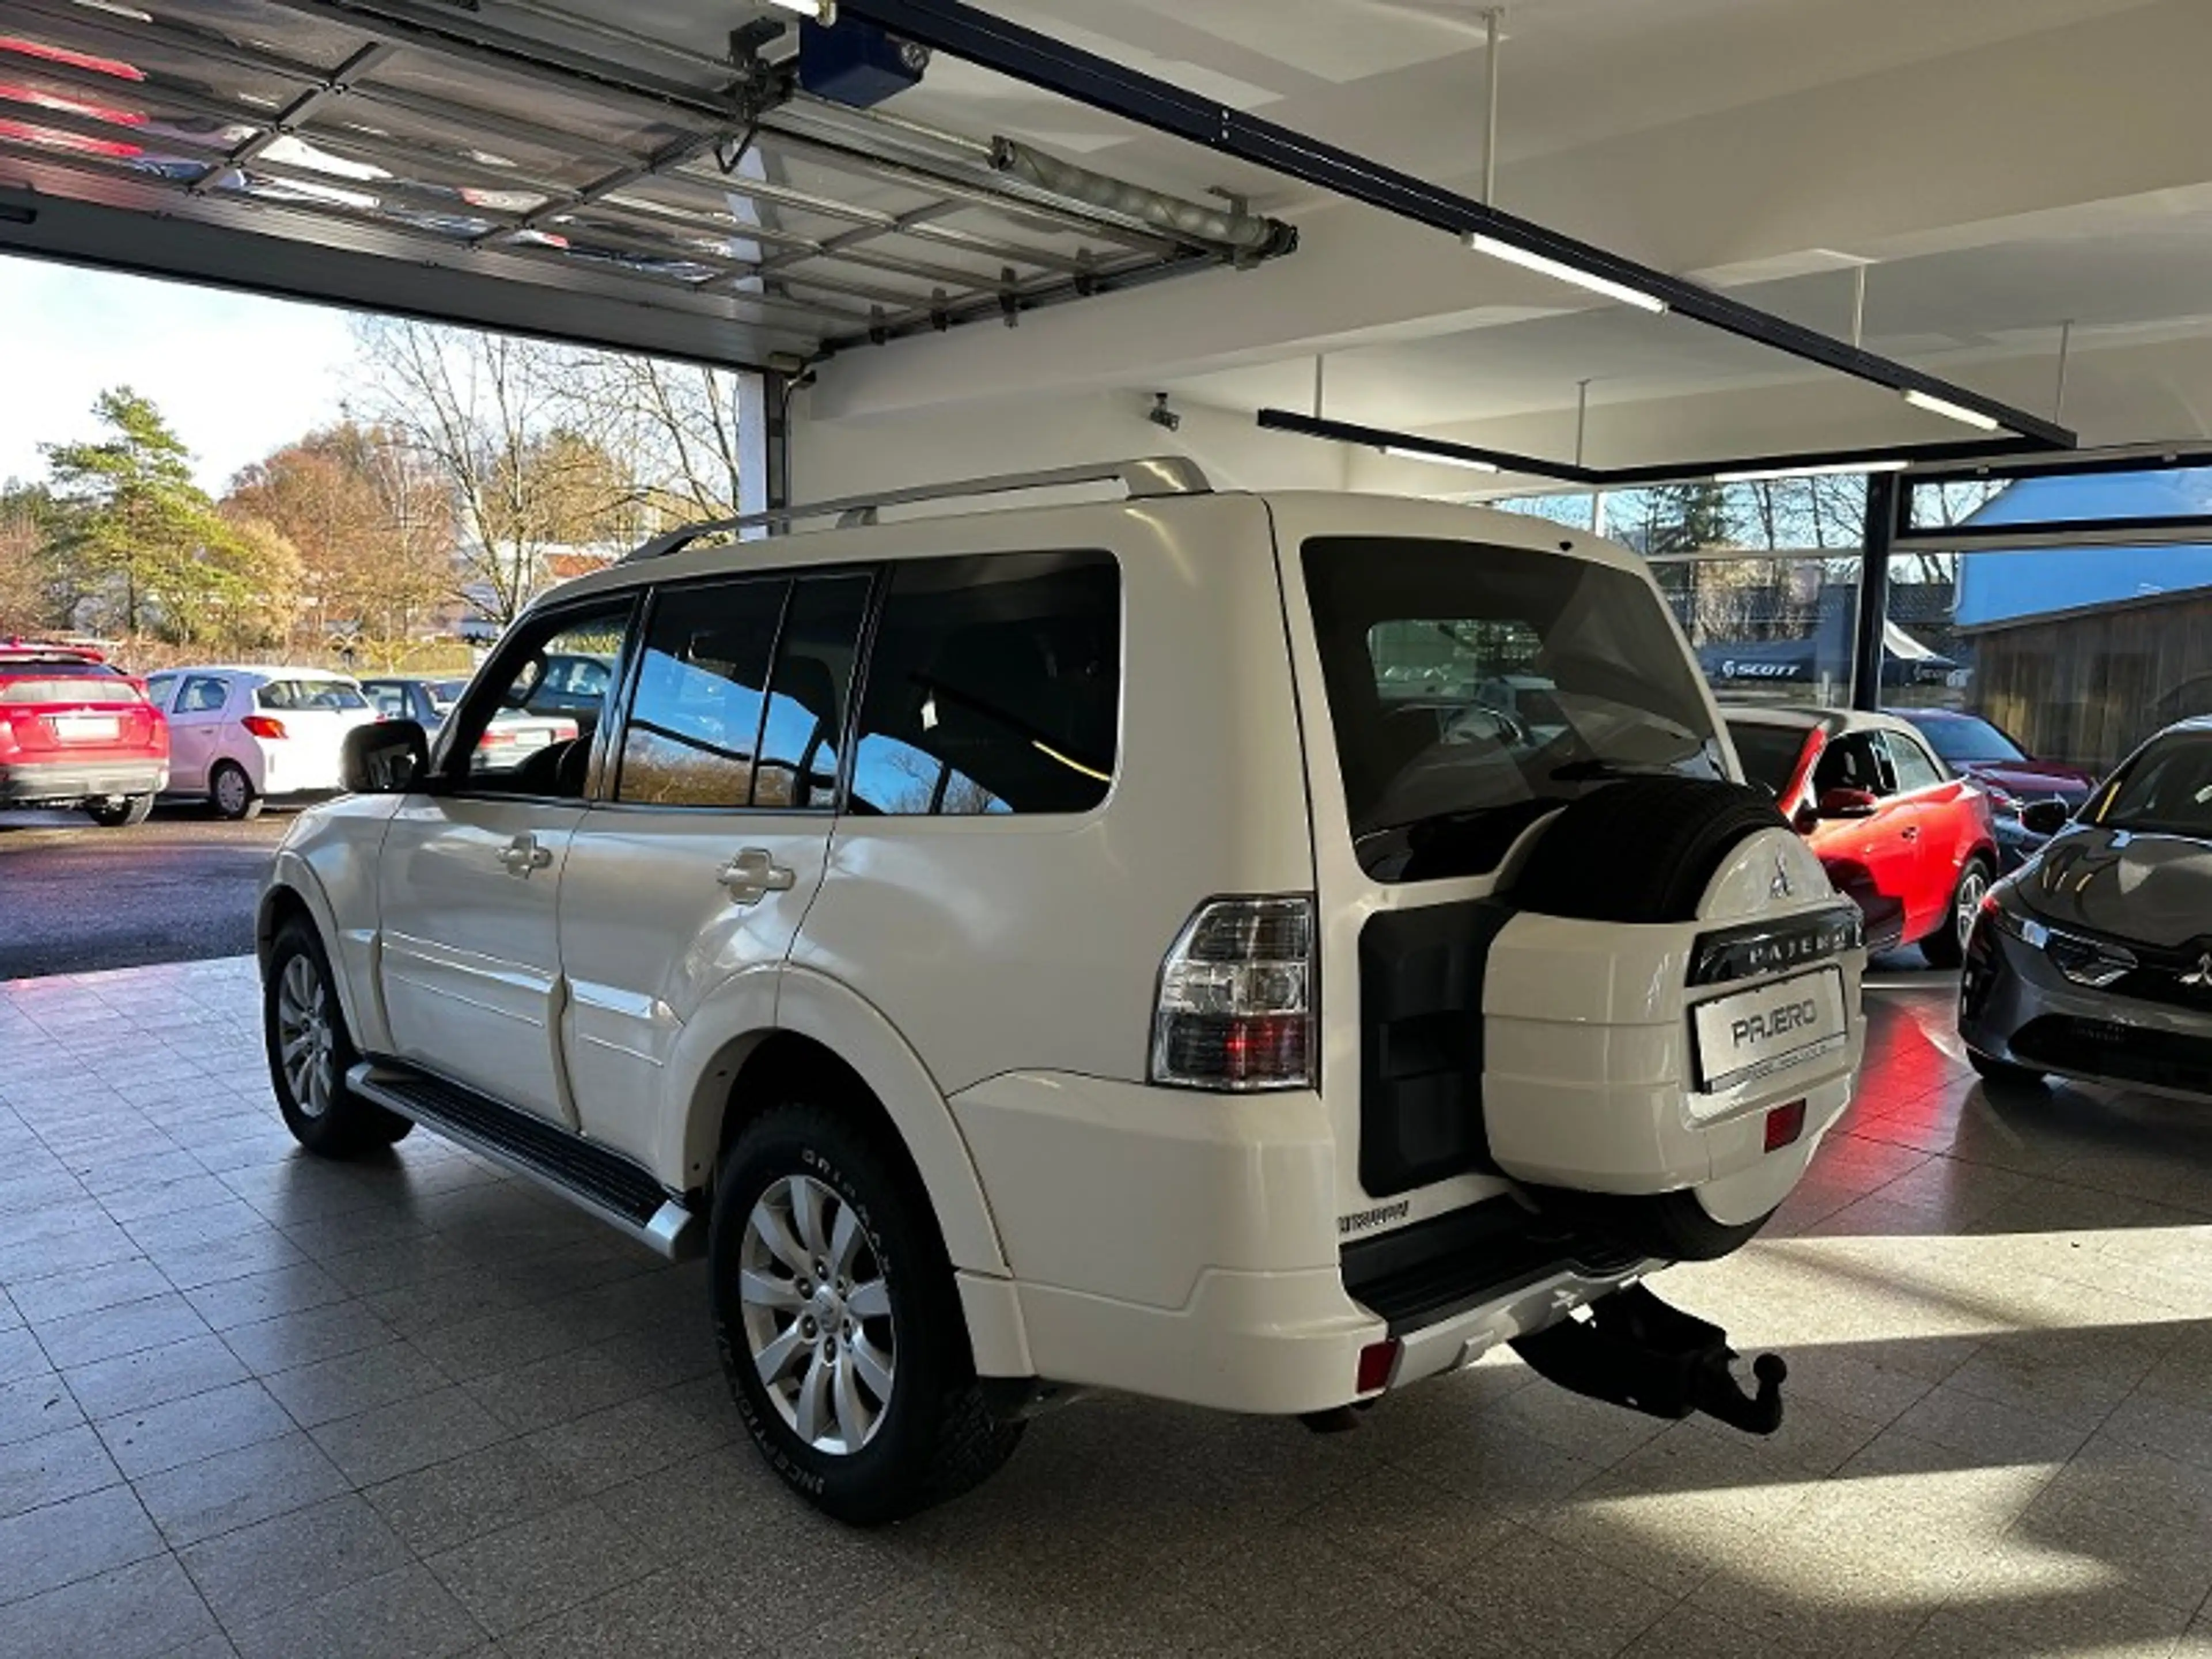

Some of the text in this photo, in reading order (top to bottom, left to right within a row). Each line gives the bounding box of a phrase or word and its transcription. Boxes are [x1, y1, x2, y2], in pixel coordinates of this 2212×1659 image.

[1736, 663, 1801, 676] SCOTT
[1749, 927, 1847, 964] PAJERO
[1731, 998, 1818, 1048] PAJERO
